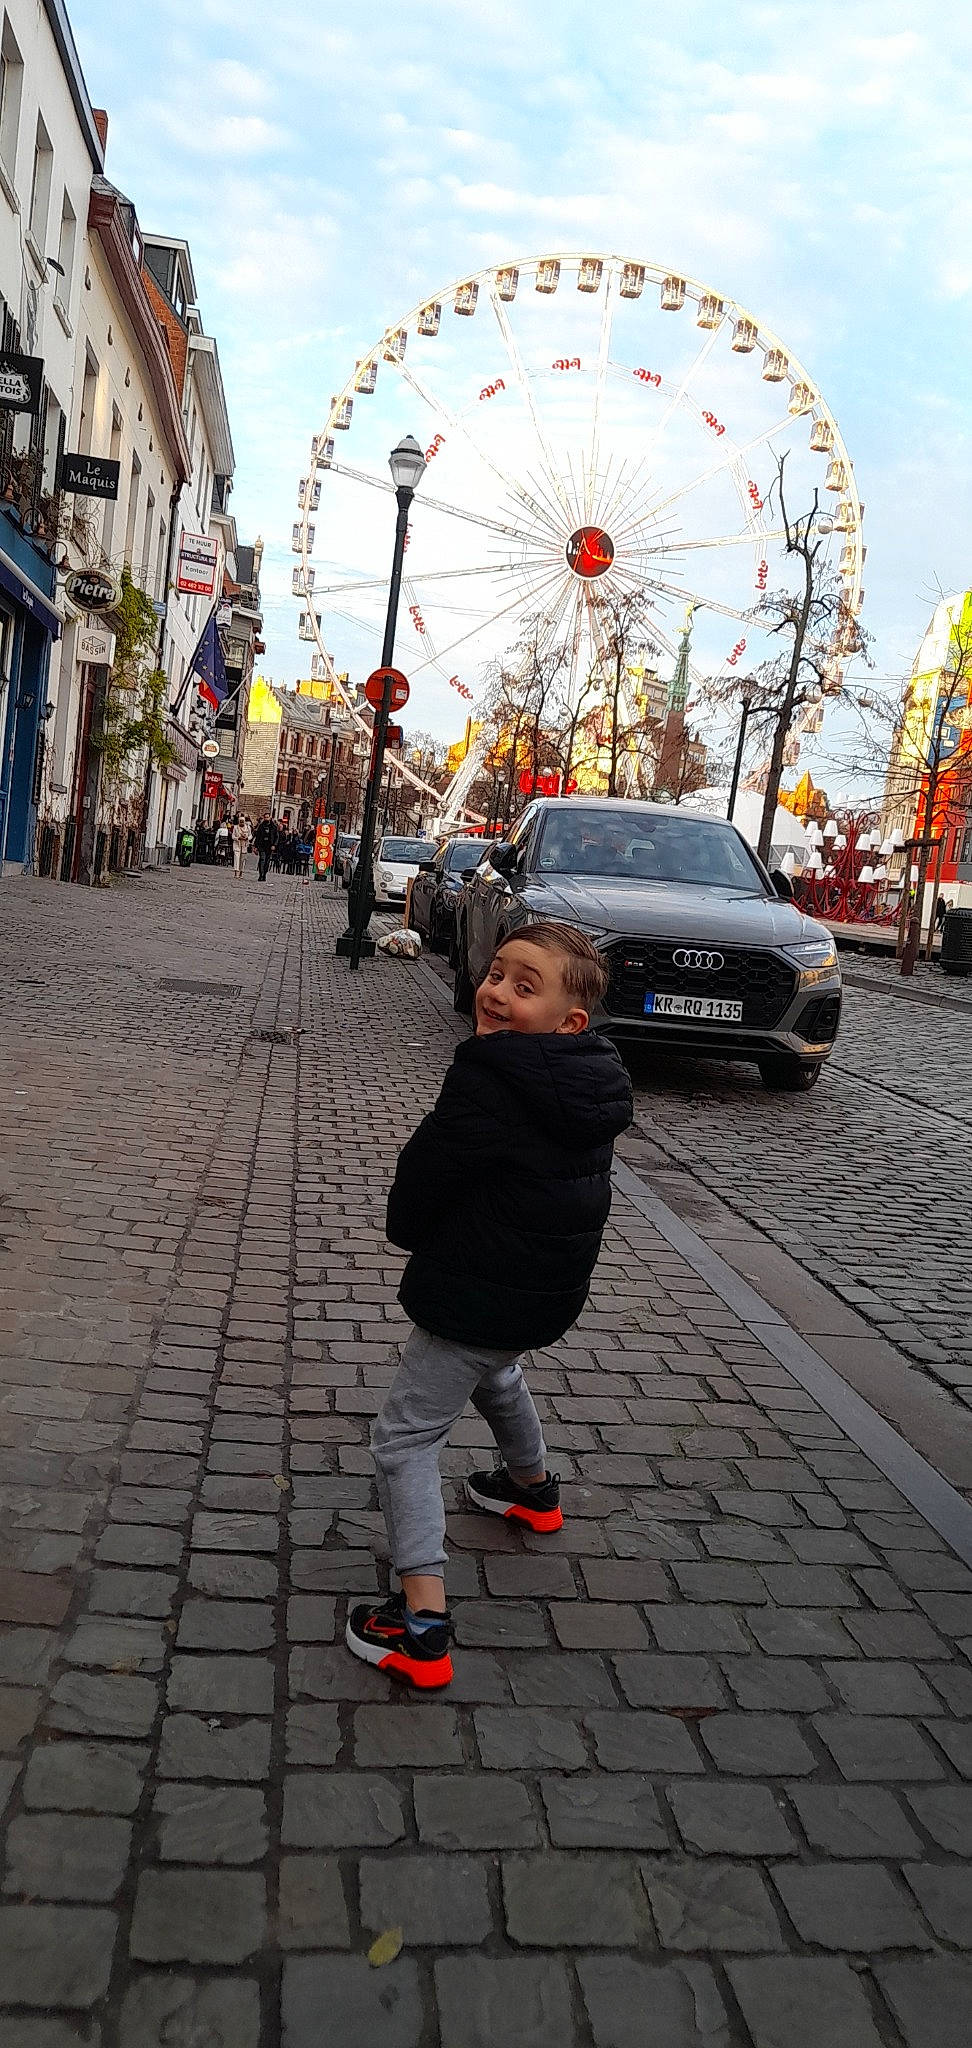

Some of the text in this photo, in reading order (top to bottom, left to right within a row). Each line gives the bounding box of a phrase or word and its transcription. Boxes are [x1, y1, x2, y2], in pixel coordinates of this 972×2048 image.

[551, 358, 580, 370] Lotto
[479, 378, 506, 401] Lotto
[632, 368, 662, 387] Lotto
[701, 411, 725, 437] Lotto
[425, 434, 446, 463] Lotto
[69, 469, 116, 491] Maquis
[86, 461, 101, 476] Le
[747, 480, 763, 510] Lotto
[754, 559, 769, 590] Lotto
[69, 577, 116, 602] Pietra
[409, 605, 426, 635] Lotto
[725, 638, 747, 666] Lotto
[449, 674, 474, 700] Lotto
[654, 996, 674, 1013] KR
[683, 999, 703, 1016] RQ
[705, 1001, 742, 1019] 1135
